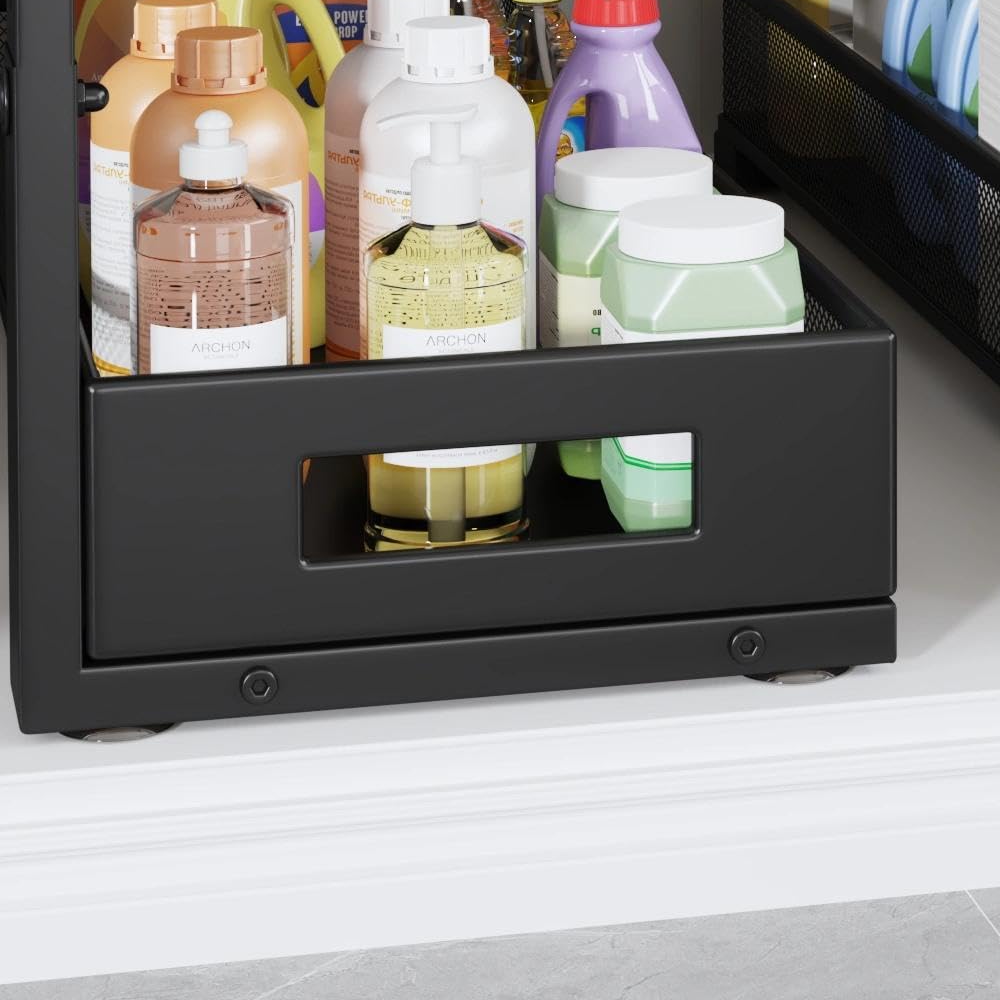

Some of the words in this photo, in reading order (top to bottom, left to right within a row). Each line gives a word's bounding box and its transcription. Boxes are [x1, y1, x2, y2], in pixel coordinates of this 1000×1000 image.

[334, 9, 368, 24] POWE
[426, 333, 487, 346] ARCHON
[191, 340, 251, 354] ARCHON
